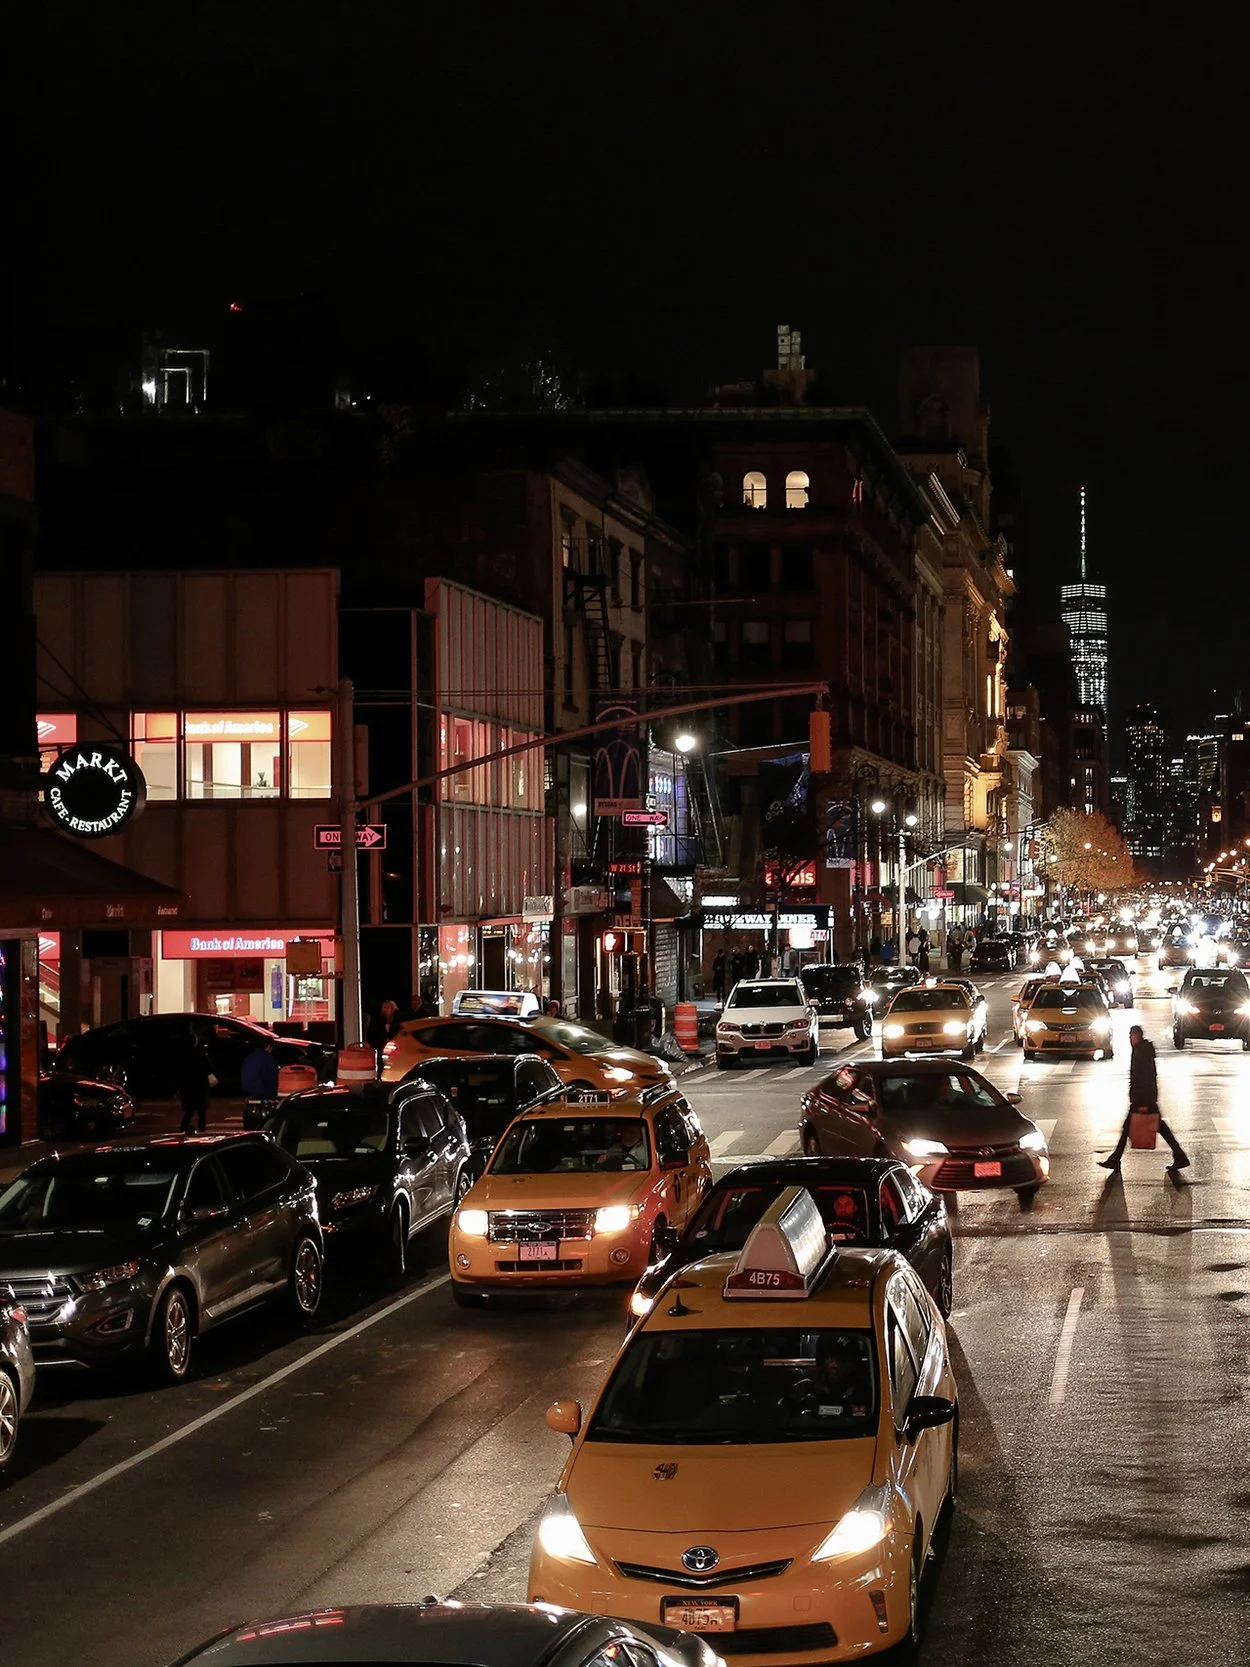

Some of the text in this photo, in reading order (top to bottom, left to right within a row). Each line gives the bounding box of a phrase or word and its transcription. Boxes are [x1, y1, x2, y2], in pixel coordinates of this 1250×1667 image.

[224, 721, 273, 734] America
[55, 752, 128, 784] MARKT
[325, 832, 342, 841] ON
[610, 865, 635, 873] W 21 St
[810, 931, 827, 939] ATM
[190, 937, 284, 951] Bank of America
[578, 1094, 598, 1103] 2T71
[749, 1272, 780, 1286] 4B75
